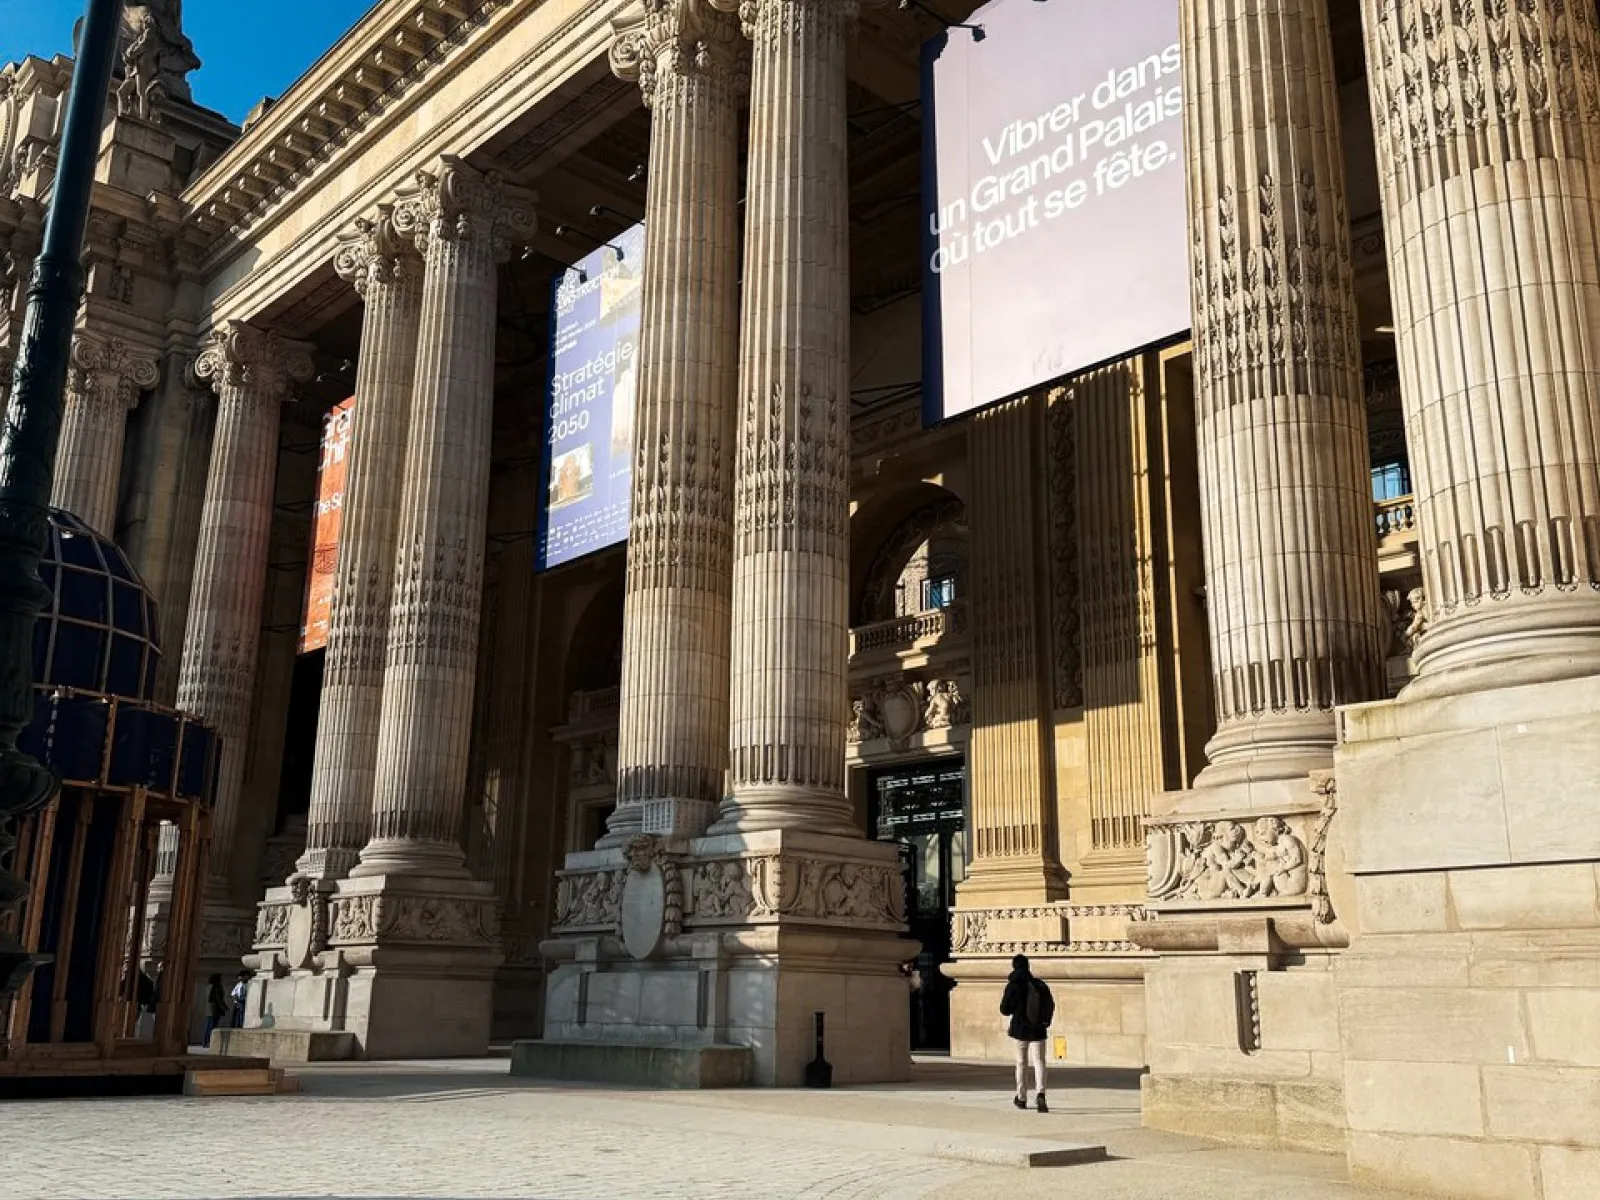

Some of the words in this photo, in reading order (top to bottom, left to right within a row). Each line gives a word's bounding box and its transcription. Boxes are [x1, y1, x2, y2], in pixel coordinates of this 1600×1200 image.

[982, 92, 1085, 166] Vibrer
[1092, 42, 1181, 111] dans
[929, 198, 966, 236] un
[971, 132, 1073, 213] Grand
[1079, 85, 1182, 161] Palais
[929, 231, 968, 274] où
[973, 195, 1038, 253] tout
[1044, 178, 1087, 219] se
[1093, 139, 1177, 196] fête.
[549, 376, 606, 419] climat
[550, 341, 633, 396] Stratégie
[547, 410, 589, 446] 2050
